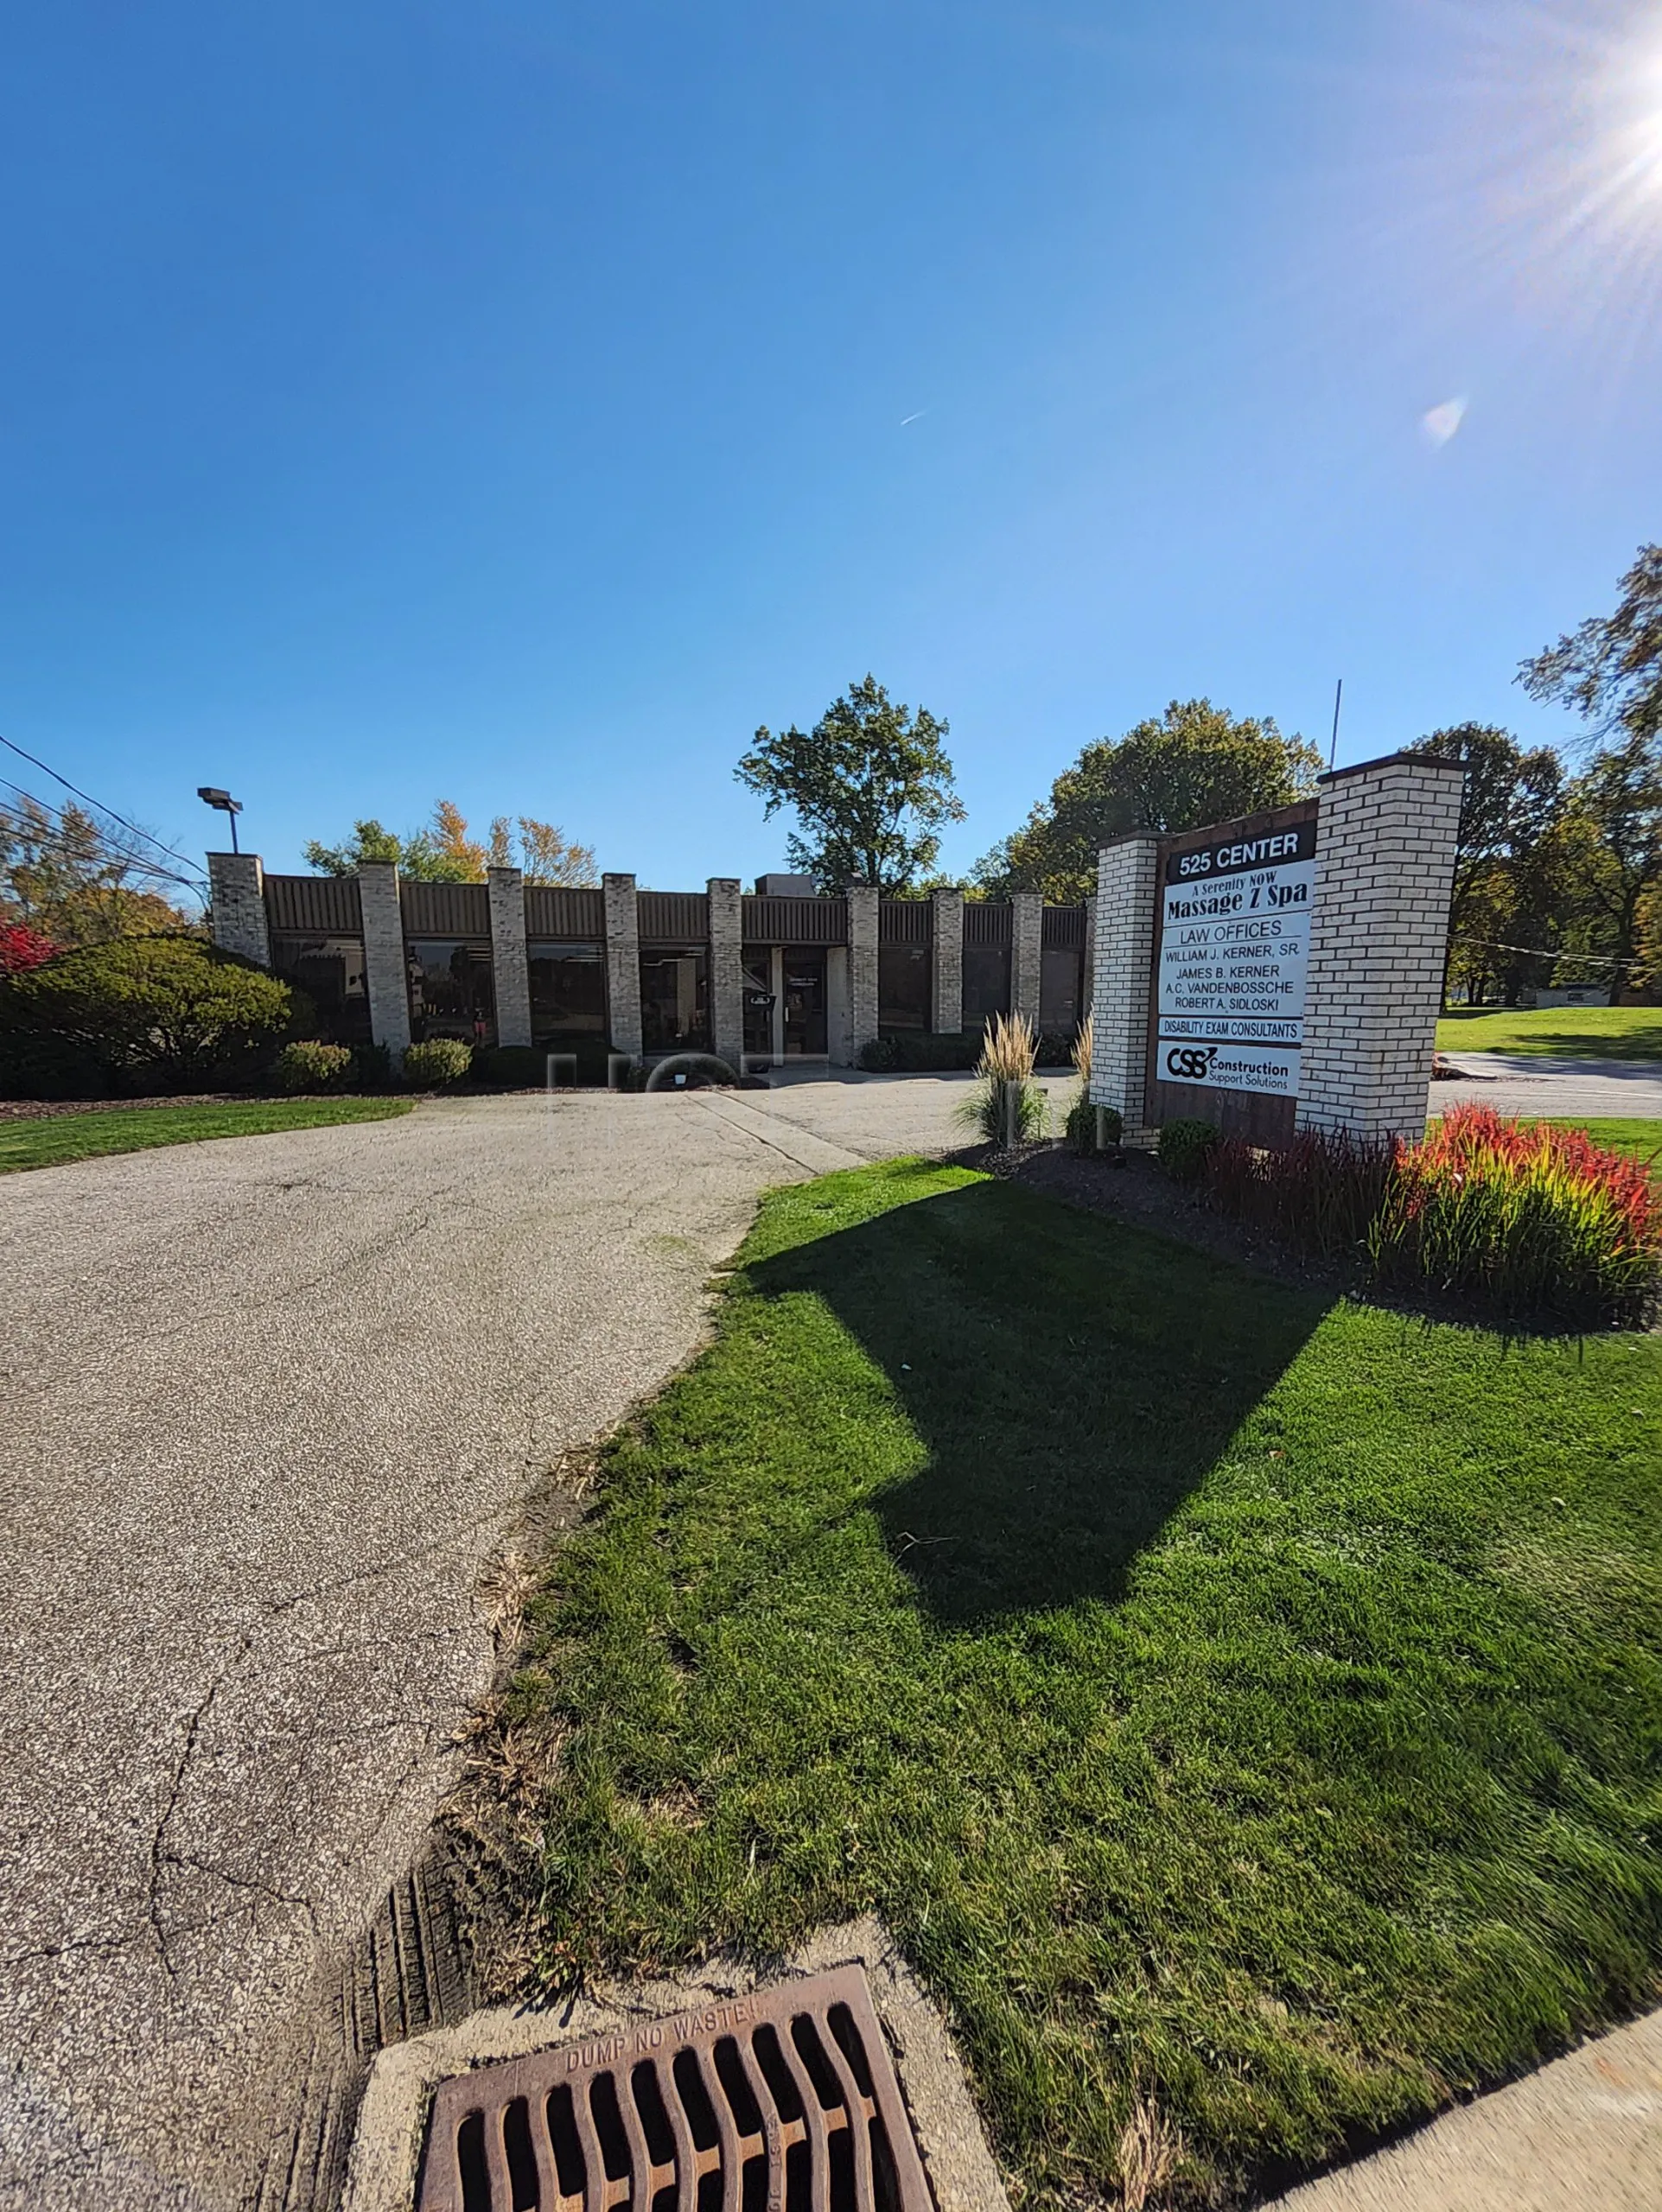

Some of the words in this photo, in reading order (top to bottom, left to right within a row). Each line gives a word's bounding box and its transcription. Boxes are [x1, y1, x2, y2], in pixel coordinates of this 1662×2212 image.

[1179, 852, 1211, 876] 525
[1216, 832, 1299, 868] CENTER
[1192, 886, 1199, 898] A
[1201, 877, 1246, 895] Serenity
[1168, 893, 1243, 920] Massage
[1267, 883, 1308, 908] Spa
[1180, 927, 1211, 944] LAW
[1214, 919, 1283, 942] OFFICES
[1166, 950, 1207, 963] WILLIAM
[1210, 948, 1219, 961] J.
[1223, 944, 1275, 960] KERNER,
[1176, 968, 1213, 980] JAMES
[1216, 967, 1226, 979] B.
[1230, 964, 1280, 979] KERNER
[1188, 981, 1295, 995] VANDENBOSSCHE
[1175, 997, 1215, 1009] ROBERT
[1216, 998, 1226, 1009] A.
[1229, 998, 1279, 1011] SIDLOSKI
[1164, 1020, 1204, 1034] DISABILITY
[1206, 1022, 1229, 1035] EXAM
[1231, 1022, 1298, 1039] CONSULTANTS
[1167, 1047, 1218, 1080] CSS
[1210, 1057, 1289, 1077] Construction
[1208, 1071, 1243, 1085] Support
[1245, 1074, 1288, 1090] Solutions
[566, 2037, 626, 2074] DUMP
[635, 2027, 662, 2053] NO
